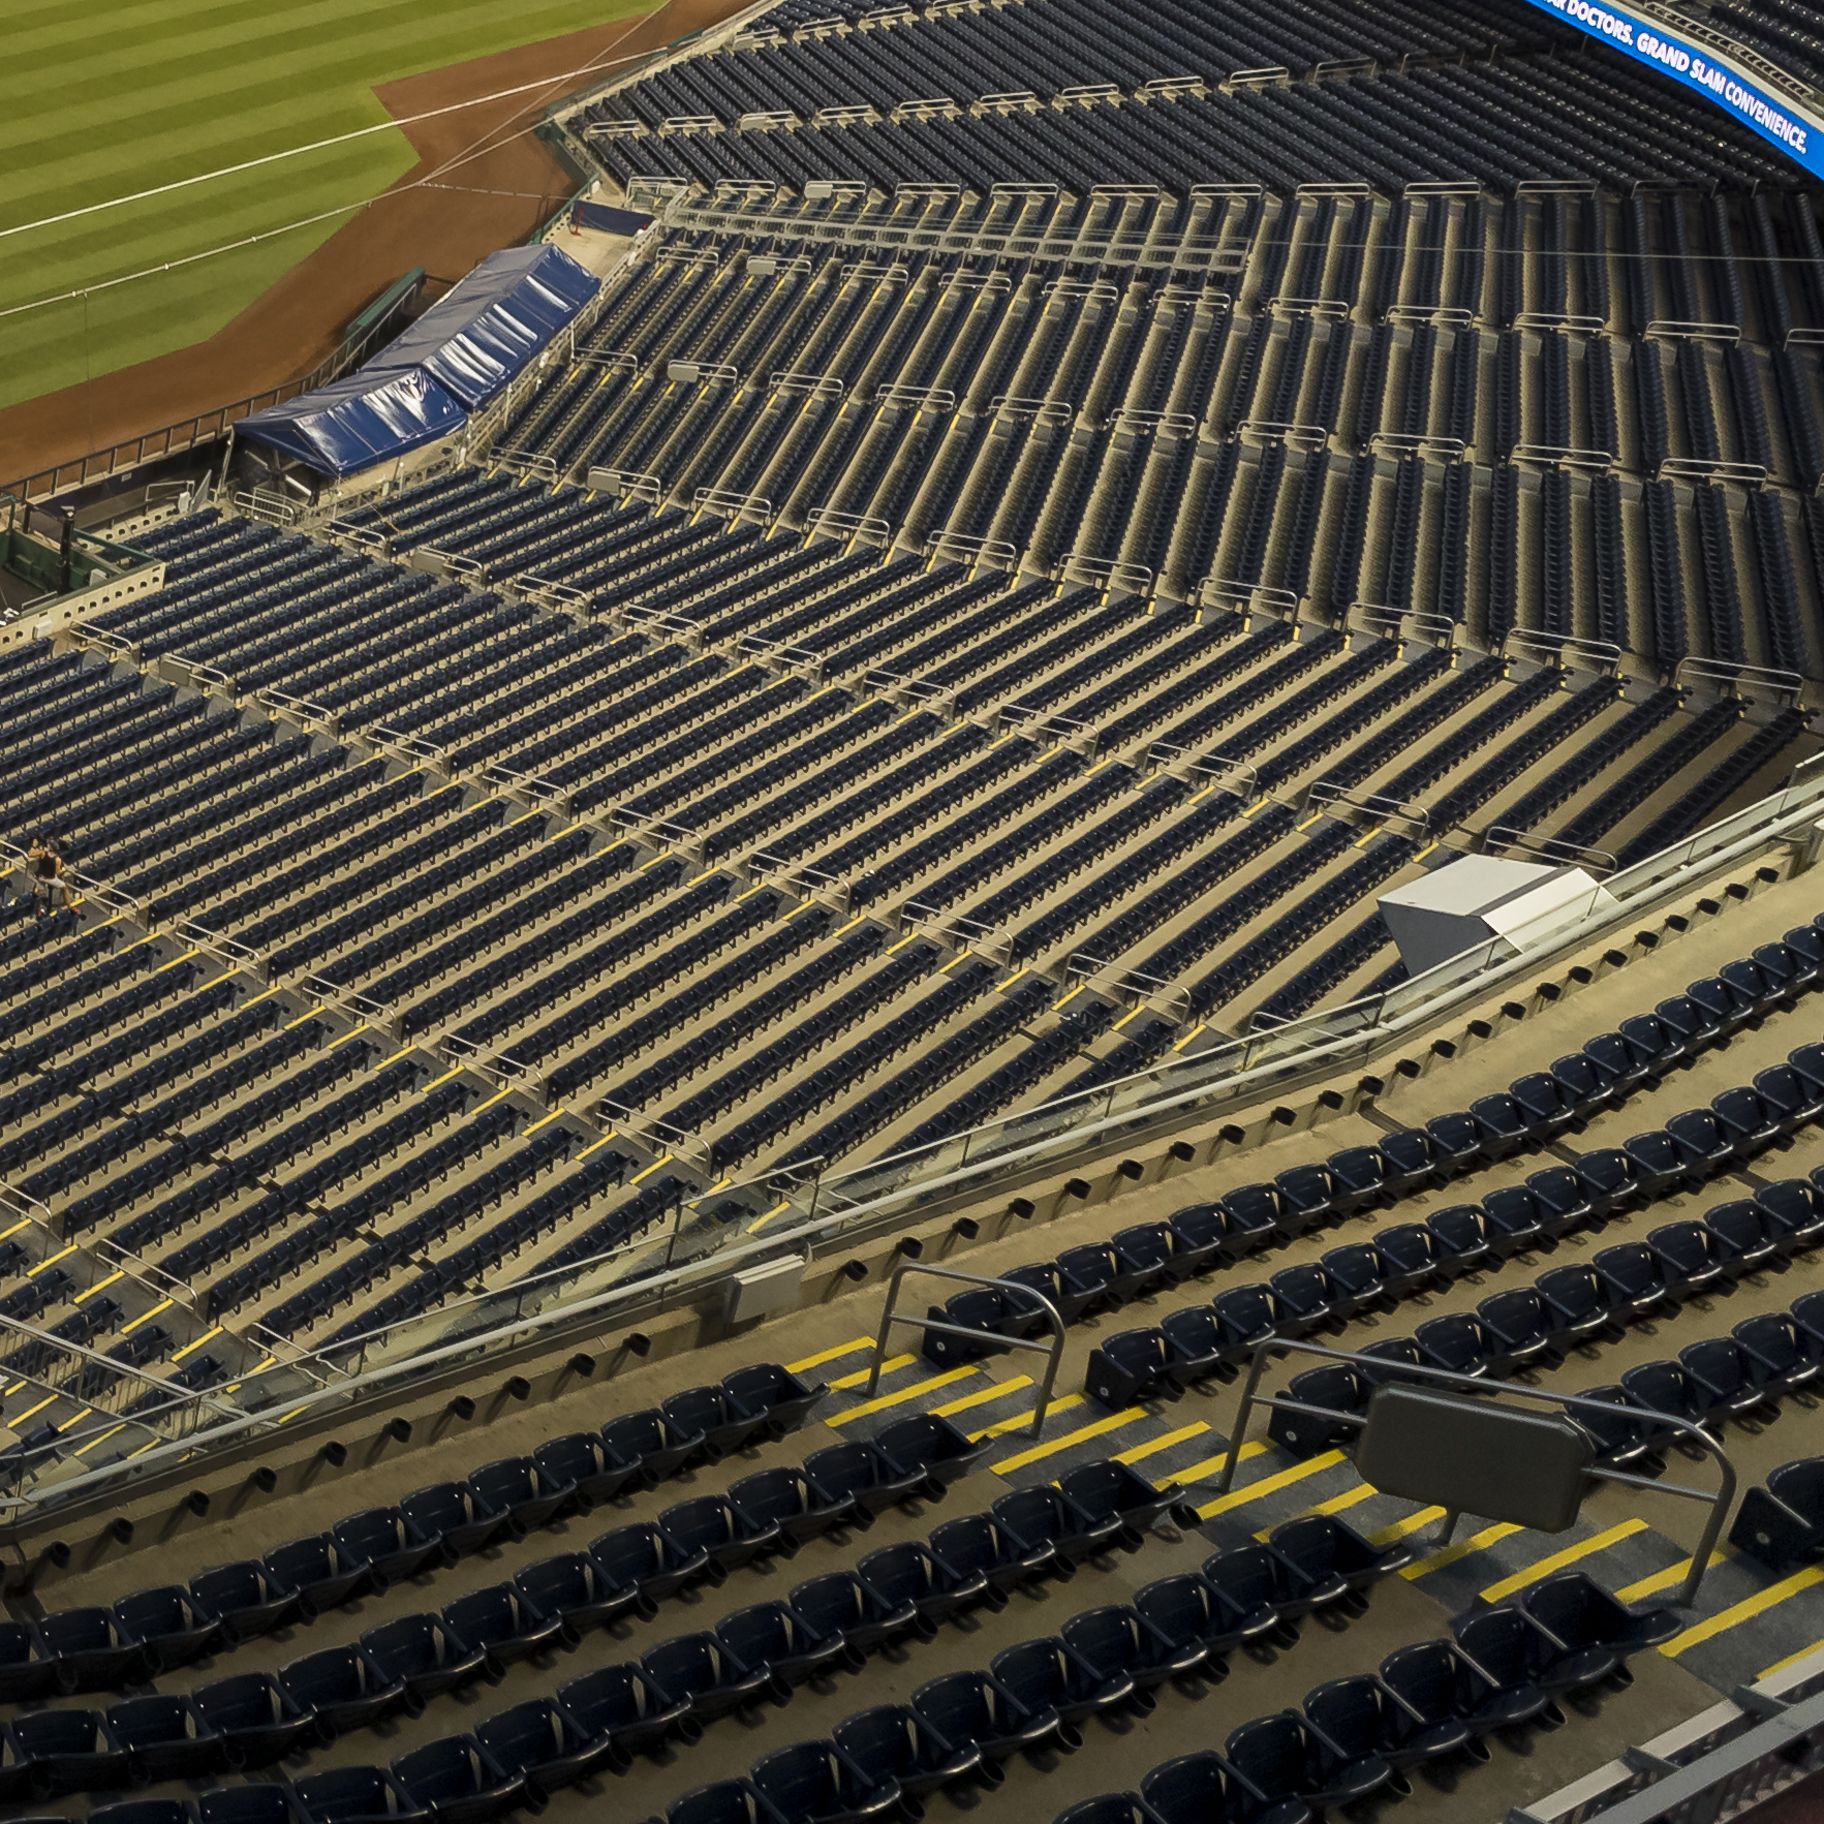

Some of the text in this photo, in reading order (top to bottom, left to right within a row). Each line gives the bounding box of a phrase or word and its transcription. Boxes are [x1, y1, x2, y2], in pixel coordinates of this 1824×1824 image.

[1636, 34, 1690, 74] GRAND
[1689, 58, 1726, 95] SLAM
[1725, 74, 1807, 155] CONVENIENCE.
